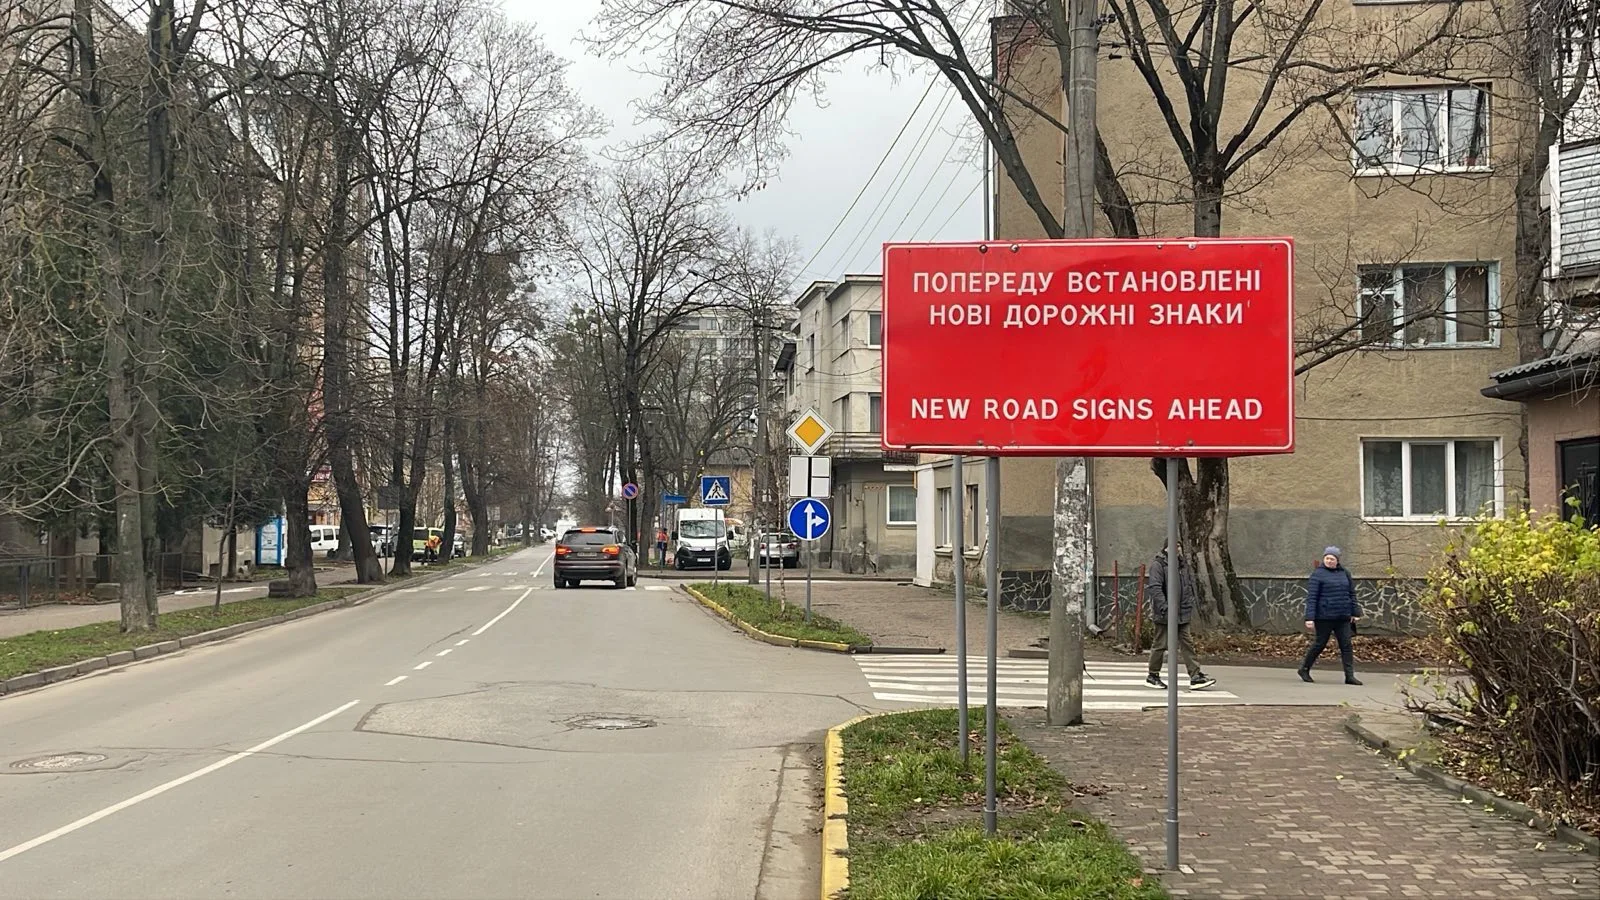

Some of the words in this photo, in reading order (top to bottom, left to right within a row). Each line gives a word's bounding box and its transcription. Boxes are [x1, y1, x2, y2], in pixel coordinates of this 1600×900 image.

[913, 271, 1054, 295] ПОПЕРЕДУ
[1068, 269, 1260, 293] ВСТАНОВЛЕНІ
[930, 303, 991, 326] НОВІ
[1003, 304, 1134, 328] ДОРОЖНІ
[1149, 302, 1243, 325] ЗНАКИ
[911, 398, 970, 420] NEW
[984, 398, 1059, 420] ROAD
[1072, 398, 1153, 420] SIGNS
[1167, 398, 1263, 420] AHEAD
